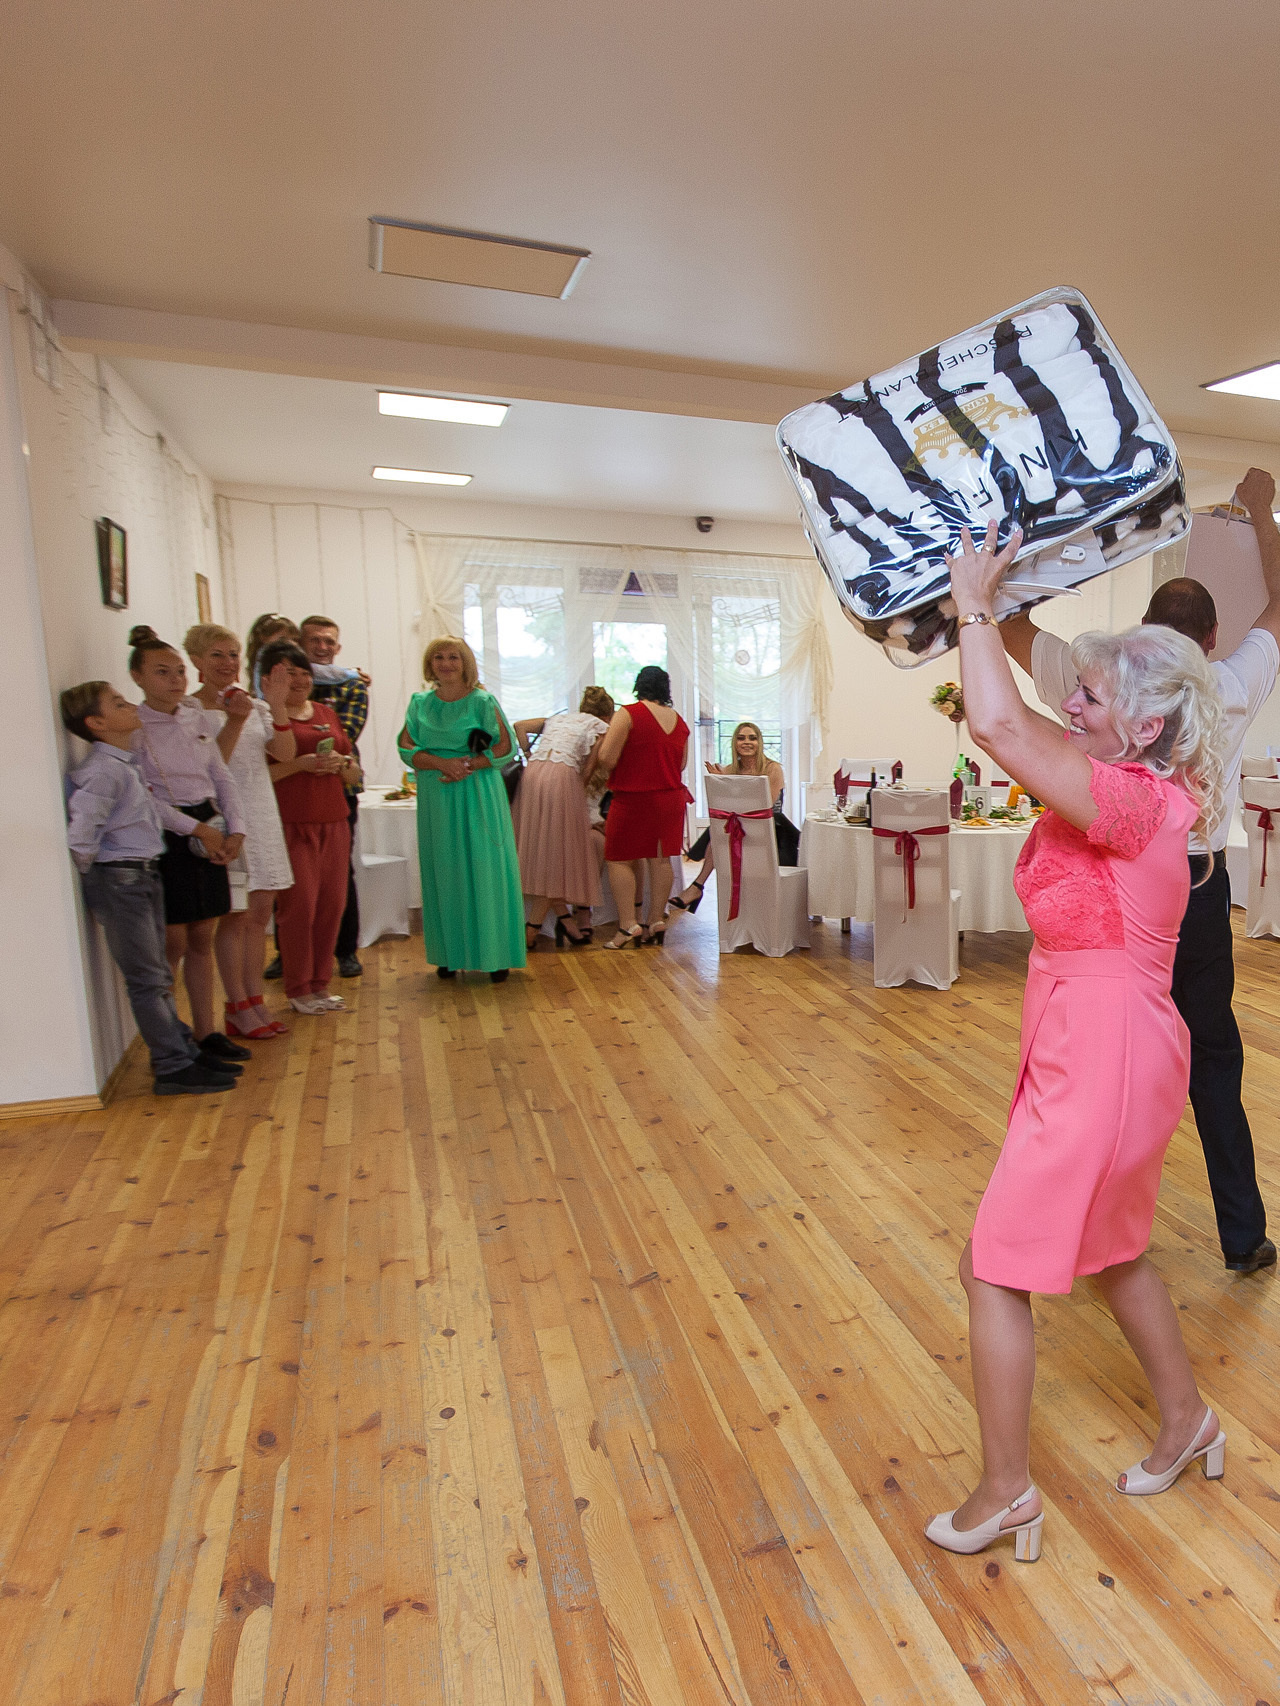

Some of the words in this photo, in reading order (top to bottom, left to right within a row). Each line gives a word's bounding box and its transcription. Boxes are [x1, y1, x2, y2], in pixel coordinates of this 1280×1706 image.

[932, 326, 1033, 371] RASCHEL
[838, 369, 928, 423] BLANKET
[975, 796, 984, 810] 6
